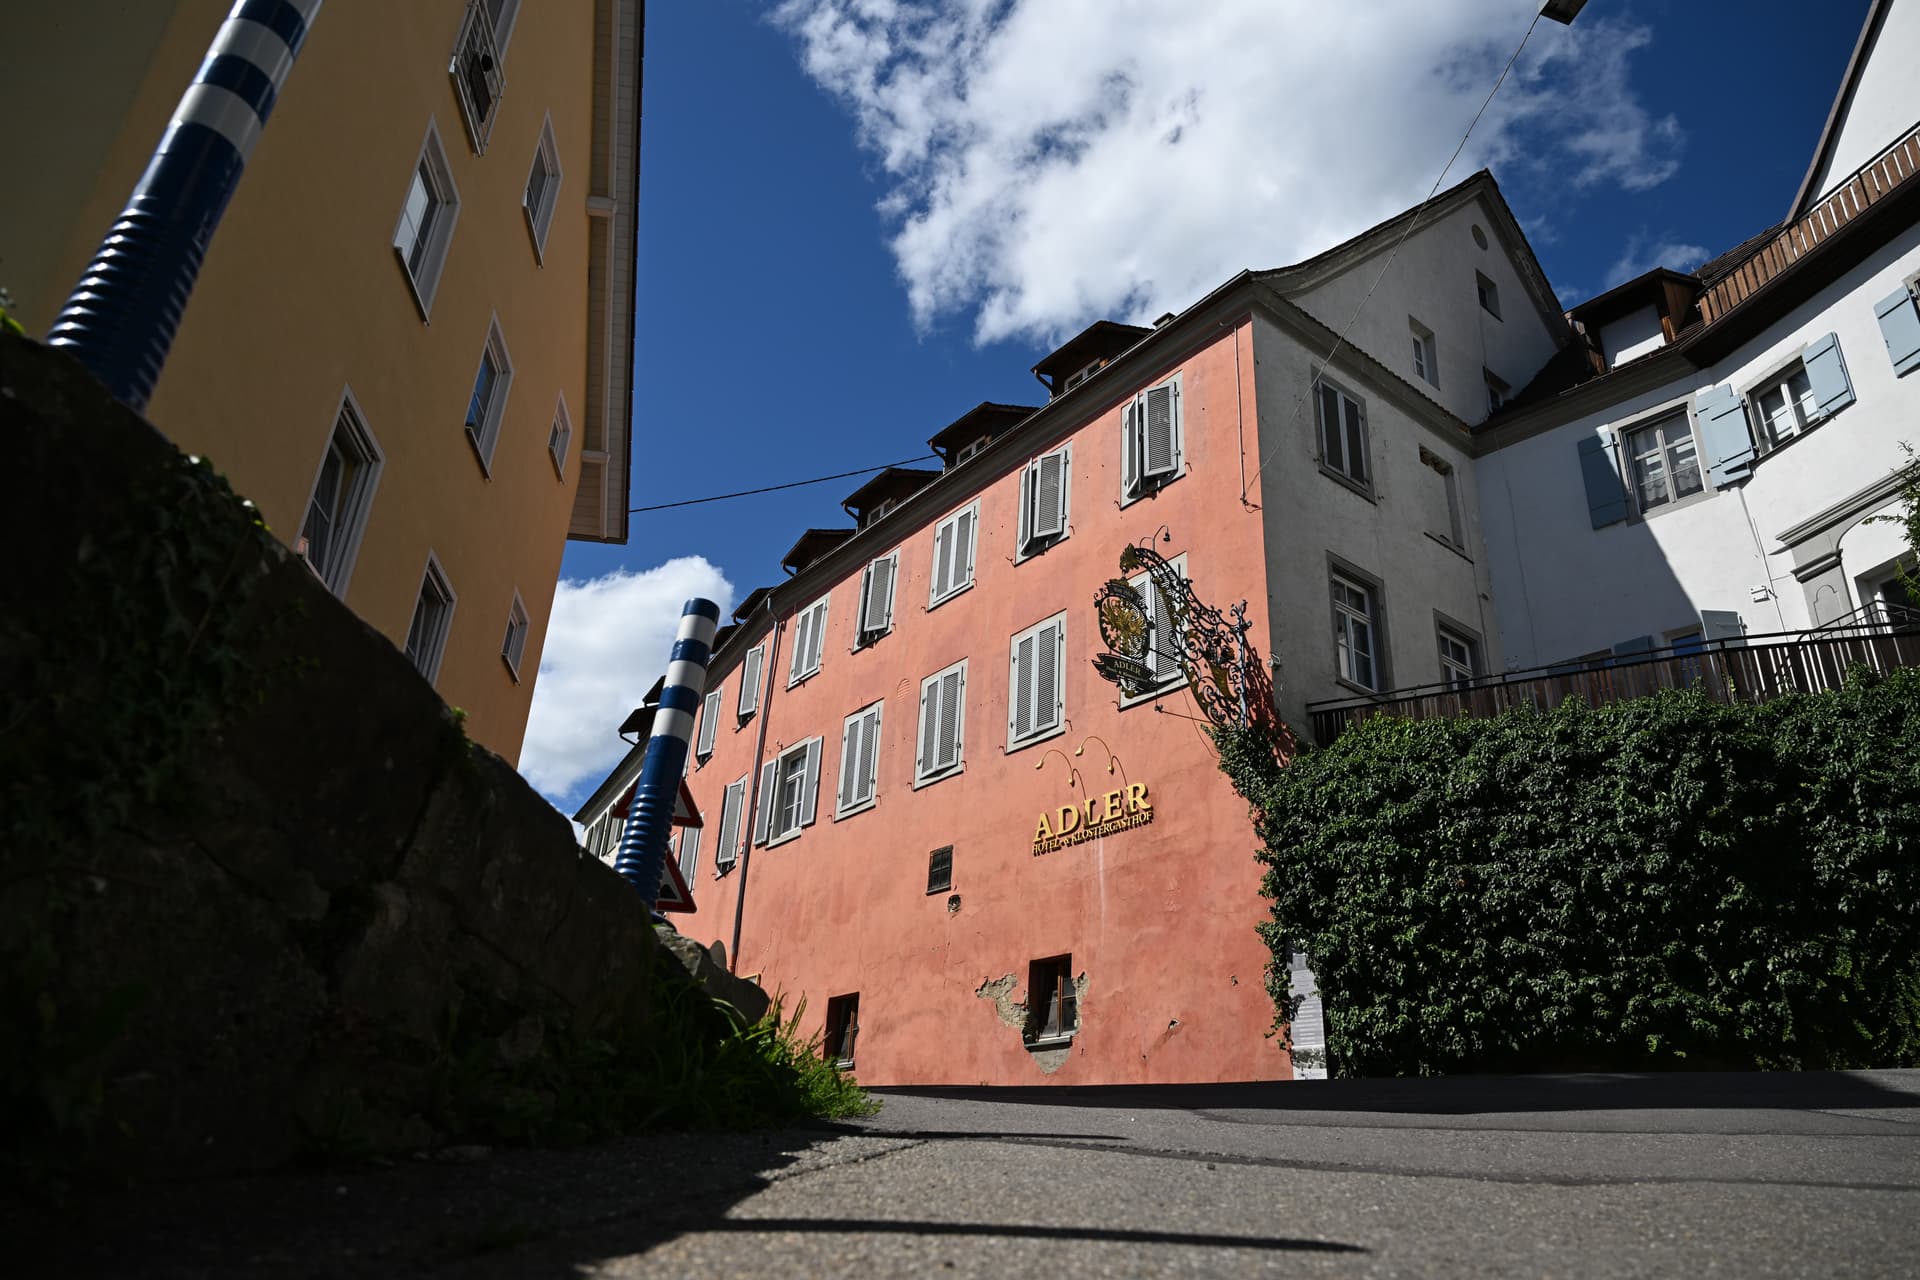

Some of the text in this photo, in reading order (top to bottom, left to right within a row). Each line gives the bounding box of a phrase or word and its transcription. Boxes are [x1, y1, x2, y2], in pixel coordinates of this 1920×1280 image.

[1113, 660, 1142, 677] ADLER
[1033, 782, 1152, 843] ADLER
[1033, 840, 1060, 855] HOTEL
[1071, 812, 1152, 843] KLOSTERGASTHOF
